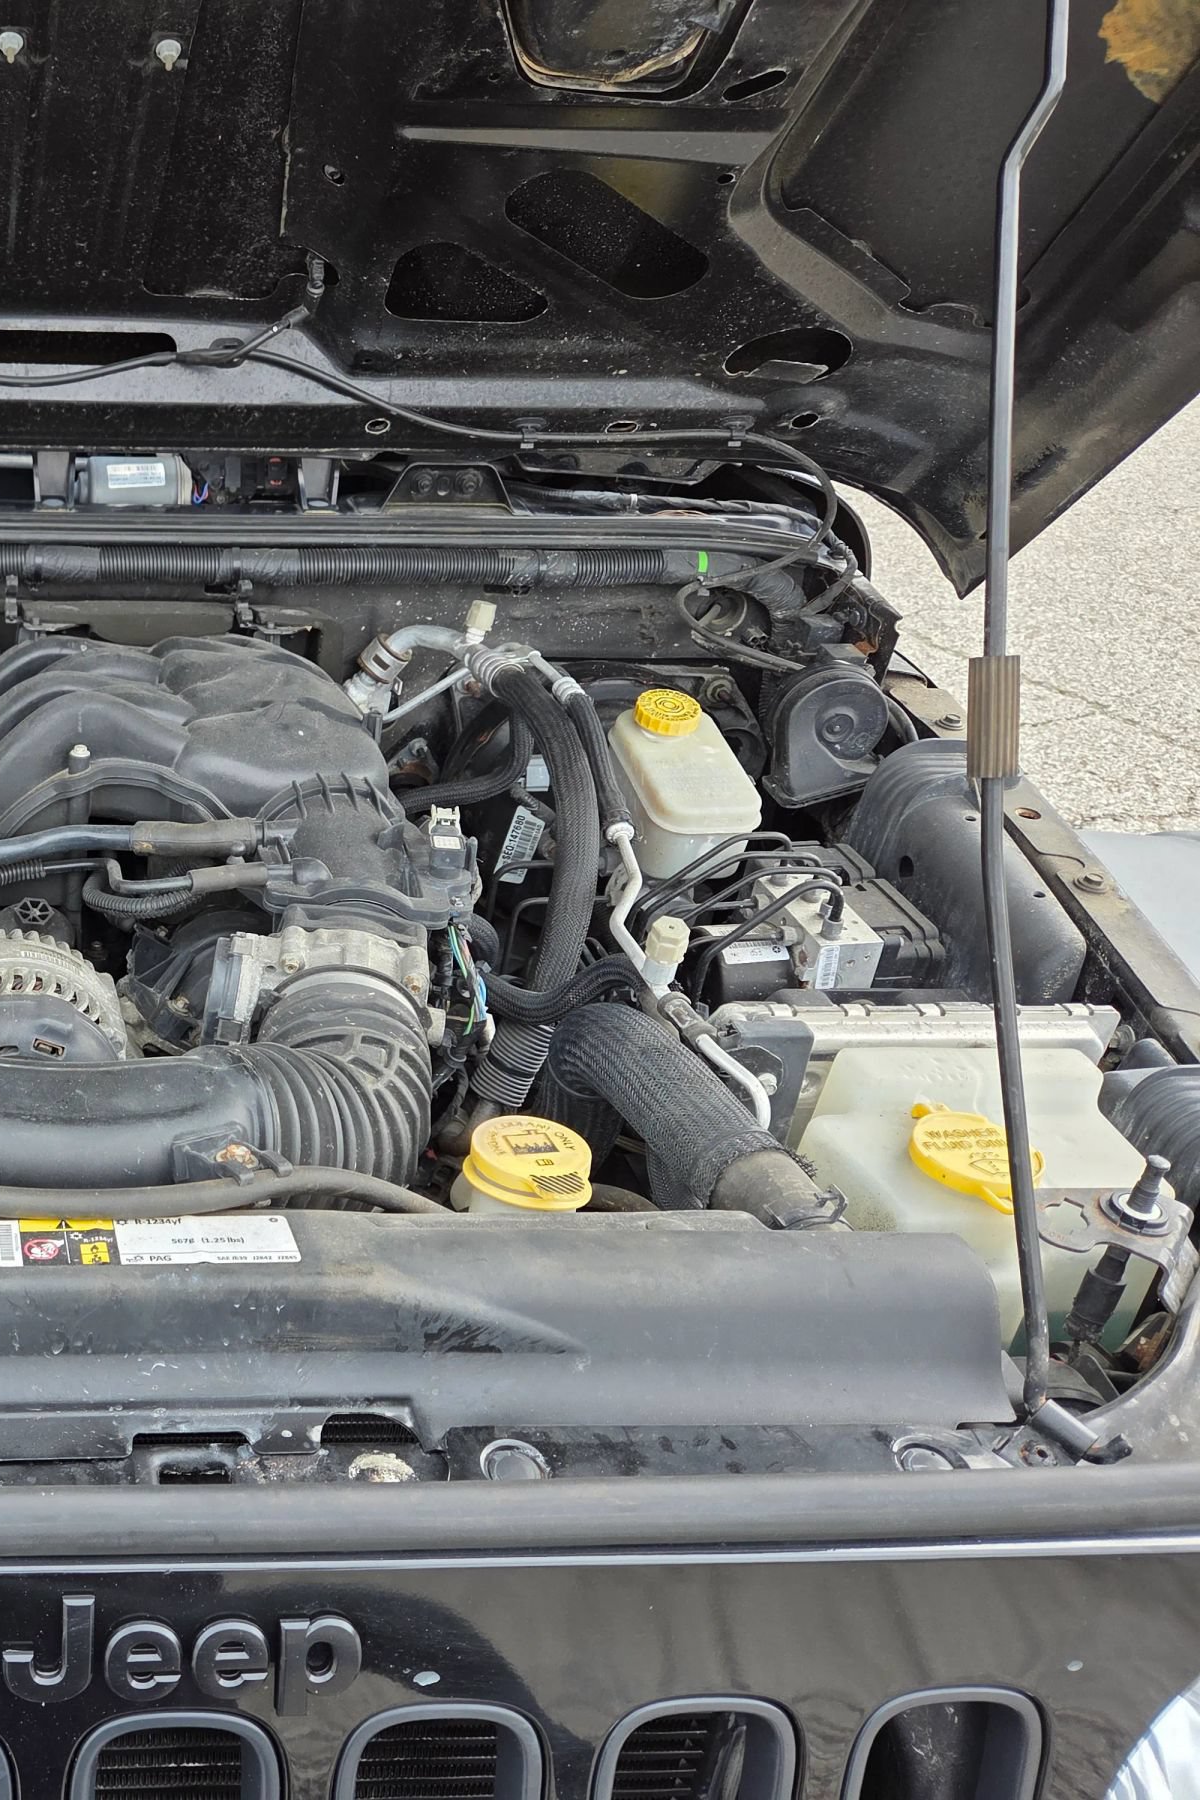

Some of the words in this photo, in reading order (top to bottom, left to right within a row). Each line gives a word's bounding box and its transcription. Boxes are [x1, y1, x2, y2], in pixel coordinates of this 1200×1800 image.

[923, 1127, 1001, 1139] WASHER
[554, 1130, 576, 1152] ONLY
[921, 1140, 973, 1152] FLUID
[226, 1236, 245, 1244] lbs)
[2, 1594, 362, 1716] Jeep
